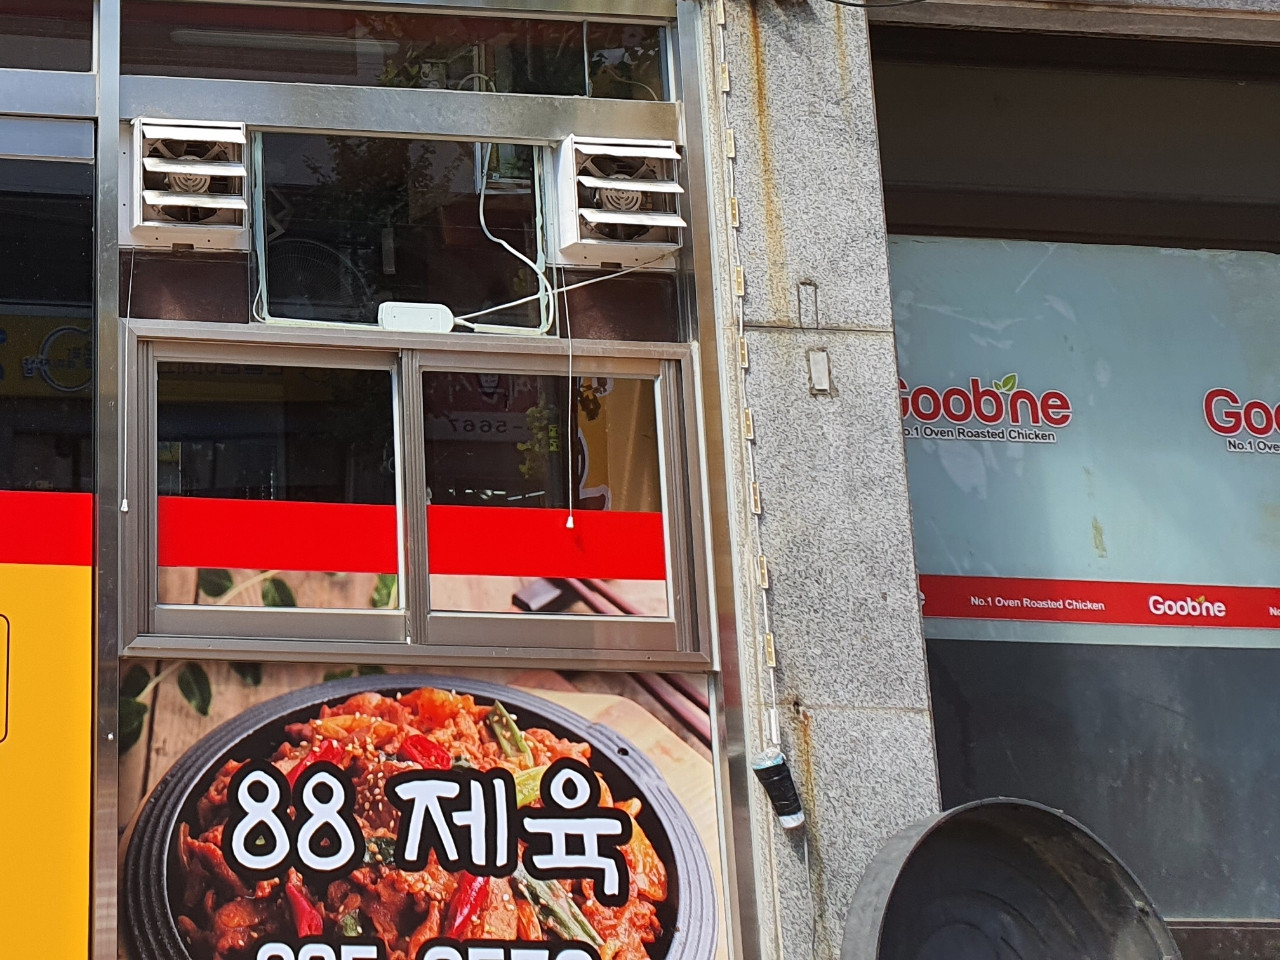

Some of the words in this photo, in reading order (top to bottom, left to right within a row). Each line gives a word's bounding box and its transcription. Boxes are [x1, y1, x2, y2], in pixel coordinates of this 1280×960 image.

[923, 426, 954, 438] Oven
[957, 427, 1005, 439] Roasted
[1008, 429, 1056, 441] Chicken
[1228, 439, 1253, 451] No.1
[995, 596, 1021, 607] Oven
[1023, 597, 1063, 609] Roasted
[1065, 599, 1106, 611] Chicken
[231, 769, 355, 871] 88
[395, 767, 622, 896] 제육
